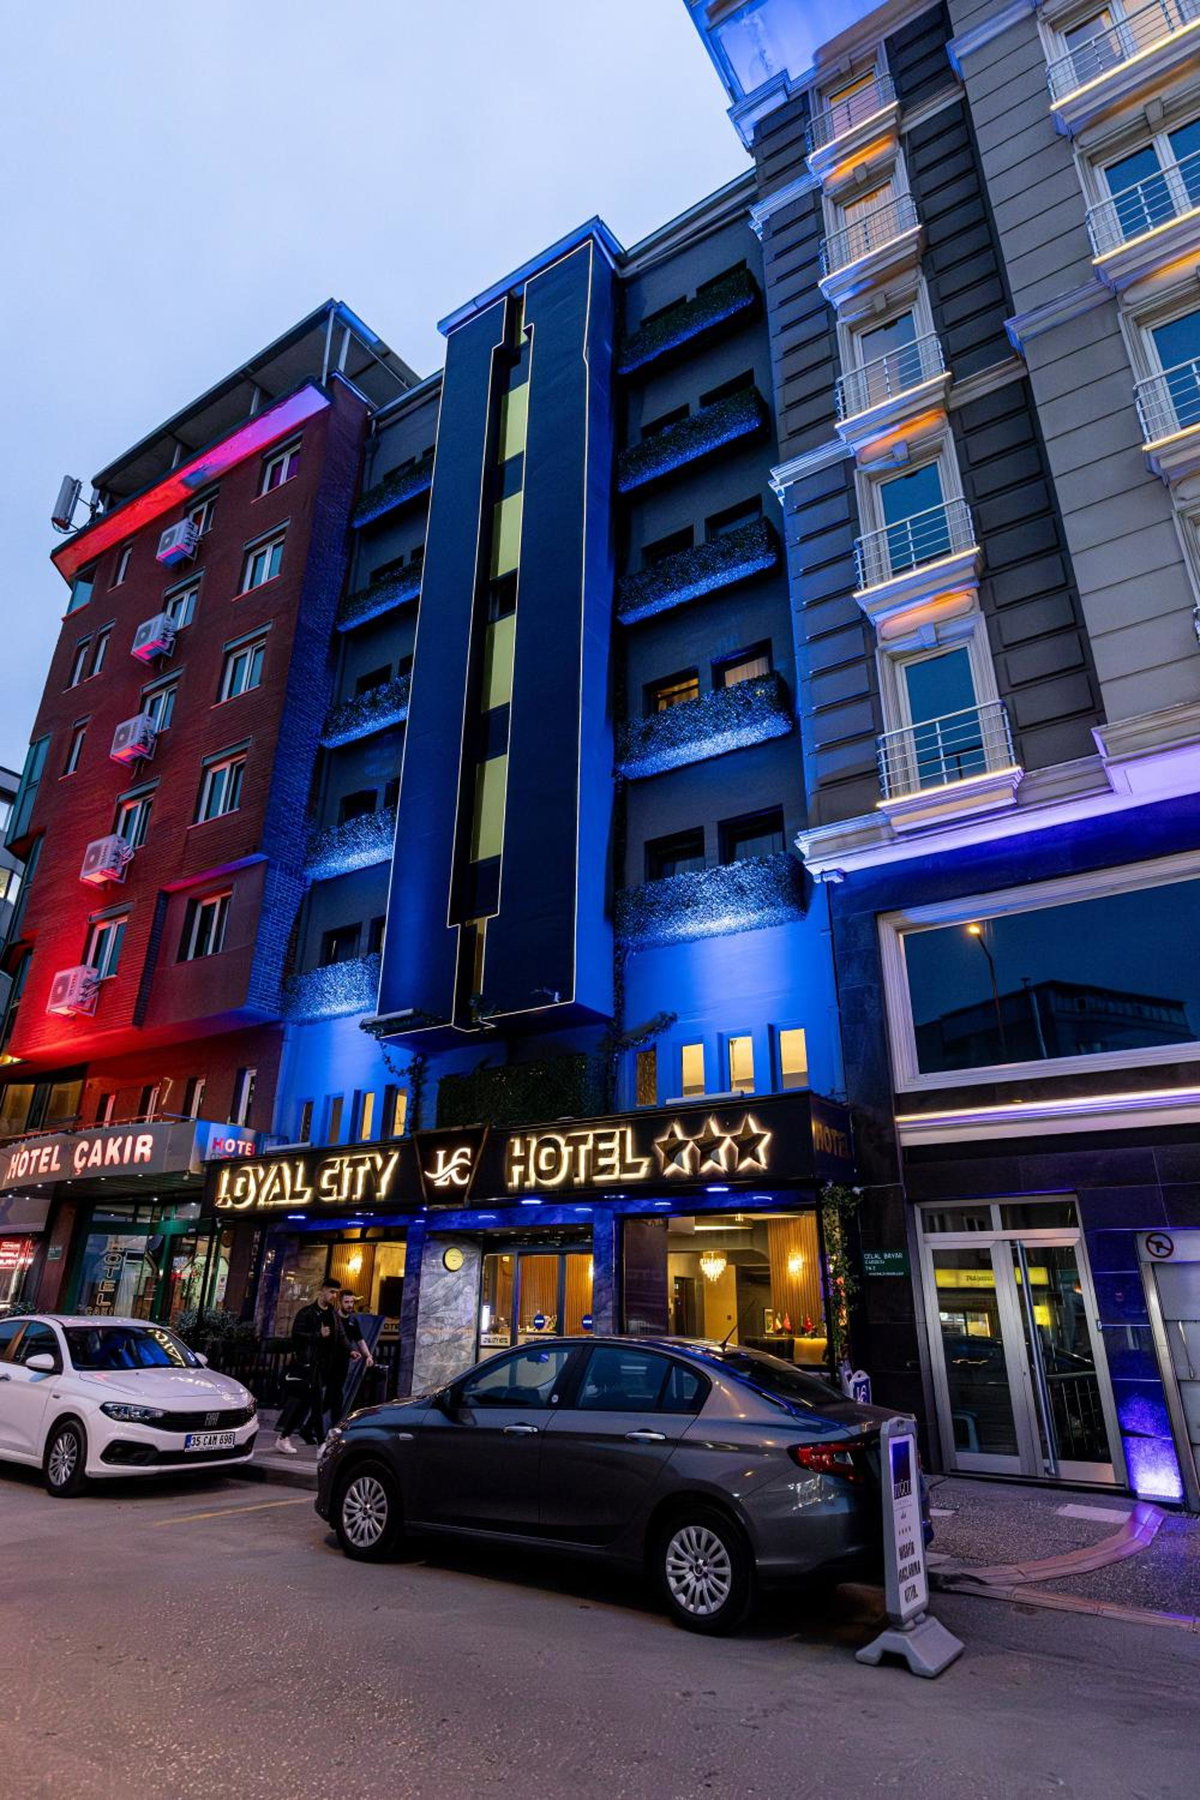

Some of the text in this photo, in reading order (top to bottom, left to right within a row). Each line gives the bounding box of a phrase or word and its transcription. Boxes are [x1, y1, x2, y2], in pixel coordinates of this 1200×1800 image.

[7, 1134, 154, 1180] HOTEL ÇAKIR
[212, 1137, 254, 1156] HOTE
[507, 1127, 652, 1187] HOTEL
[216, 1151, 400, 1208] LOYAL CITY
